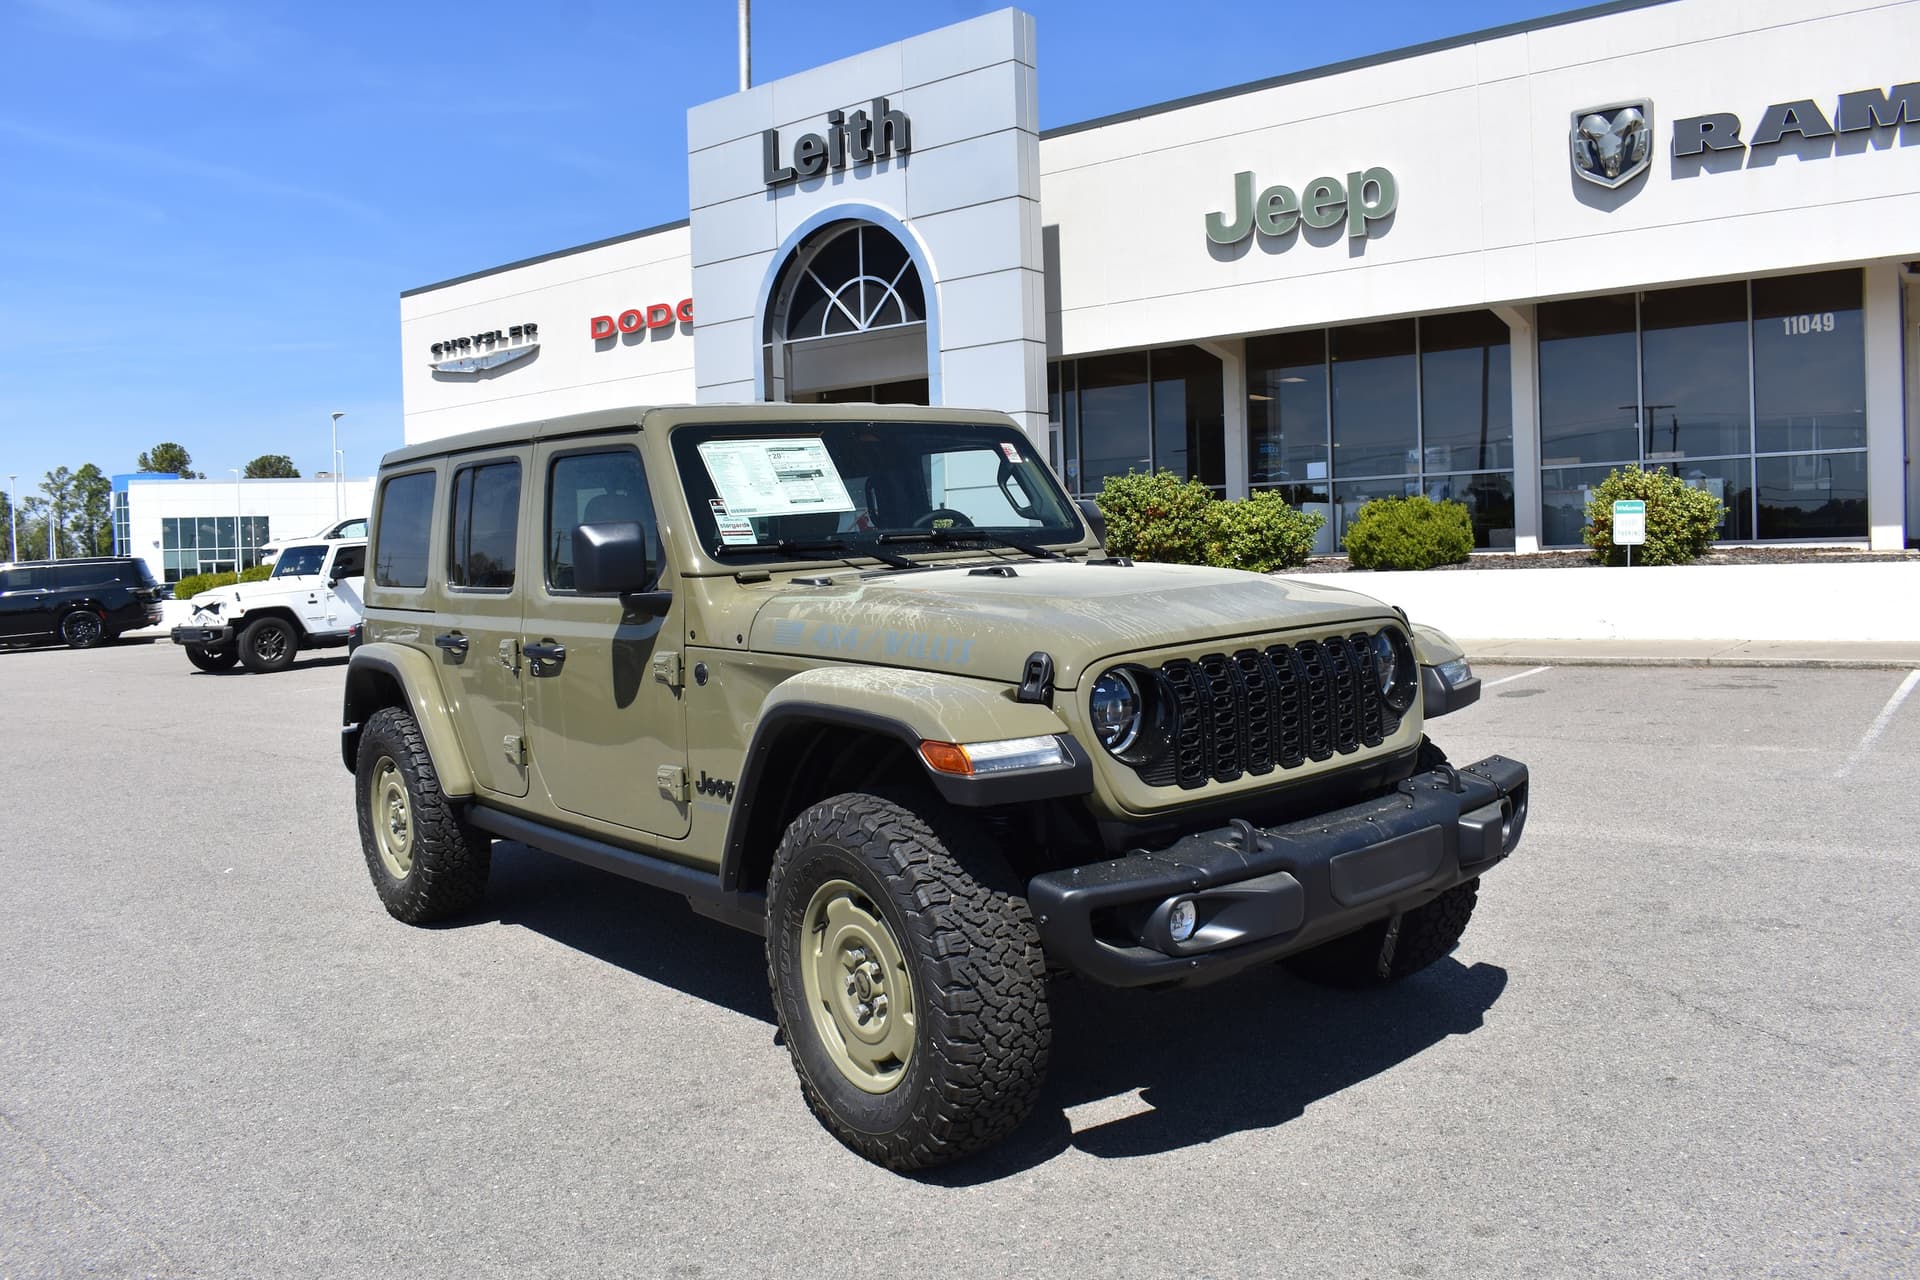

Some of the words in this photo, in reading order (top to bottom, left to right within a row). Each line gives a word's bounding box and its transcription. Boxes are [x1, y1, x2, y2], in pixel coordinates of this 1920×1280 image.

[762, 97, 911, 185] Leith
[1673, 82, 1920, 157] RAM
[1205, 167, 1399, 244] Jeep
[430, 323, 538, 355] CHRYSLER
[1783, 312, 1834, 336] 11049
[695, 770, 735, 804] Jeep
